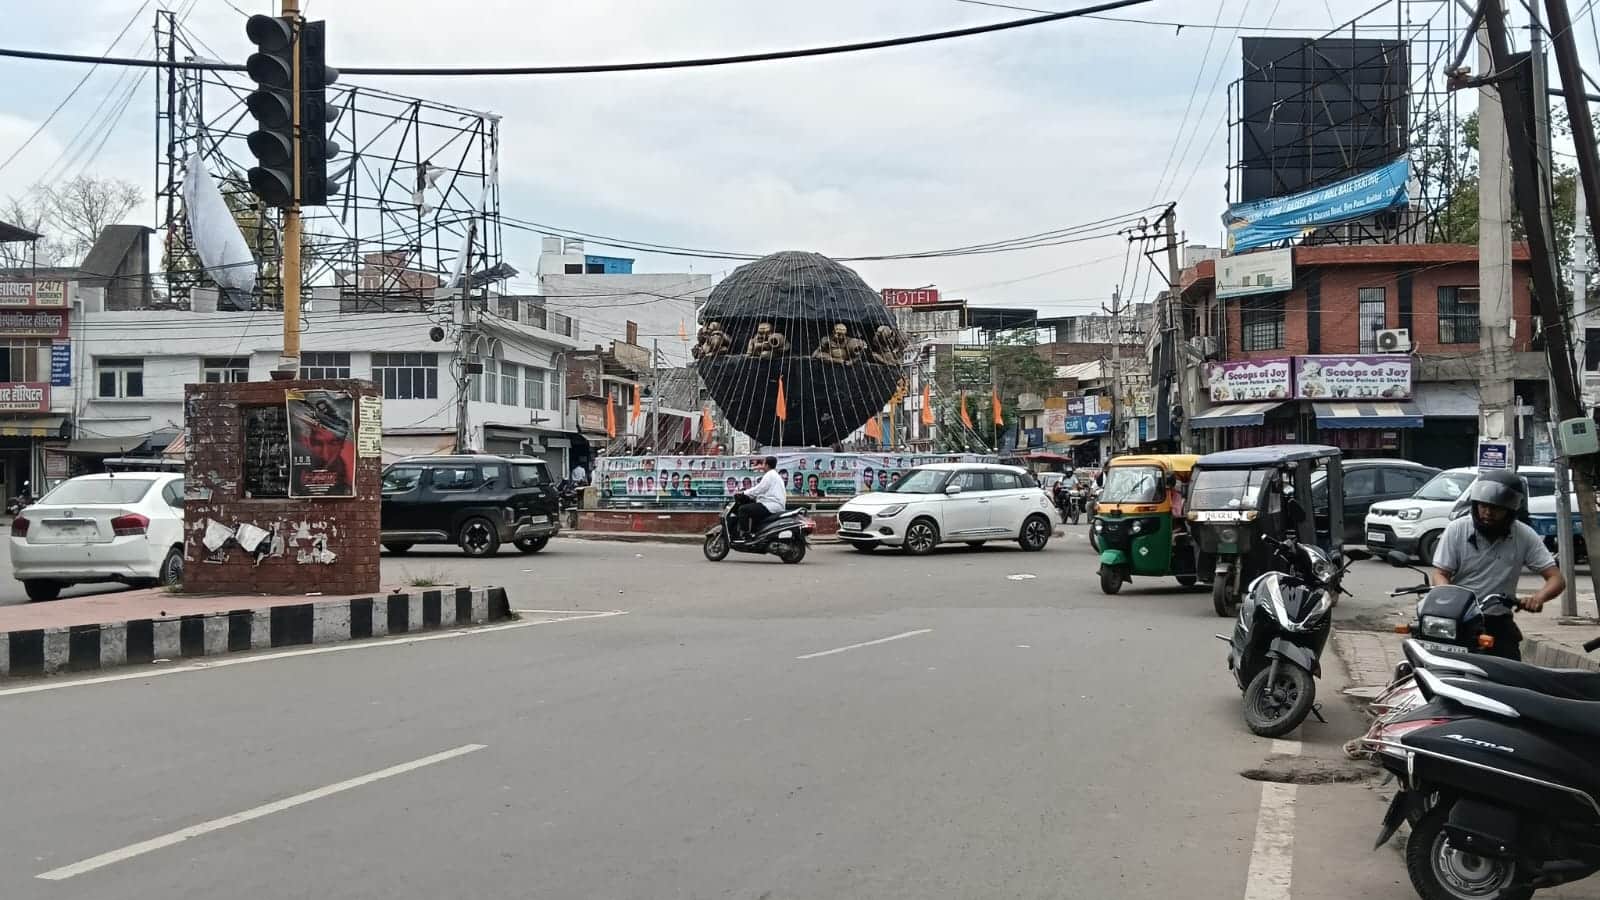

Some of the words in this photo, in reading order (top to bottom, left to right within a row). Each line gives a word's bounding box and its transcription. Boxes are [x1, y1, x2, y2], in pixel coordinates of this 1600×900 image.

[39, 280, 62, 291] 24/7
[1228, 370, 1258, 381] Scoops
[1259, 369, 1269, 378] of
[1270, 368, 1287, 379] Joy
[1326, 368, 1369, 378] Scoops
[1371, 368, 1384, 377] of
[1386, 368, 1409, 378] Joy
[12, 385, 43, 401] हॉस्पिटल
